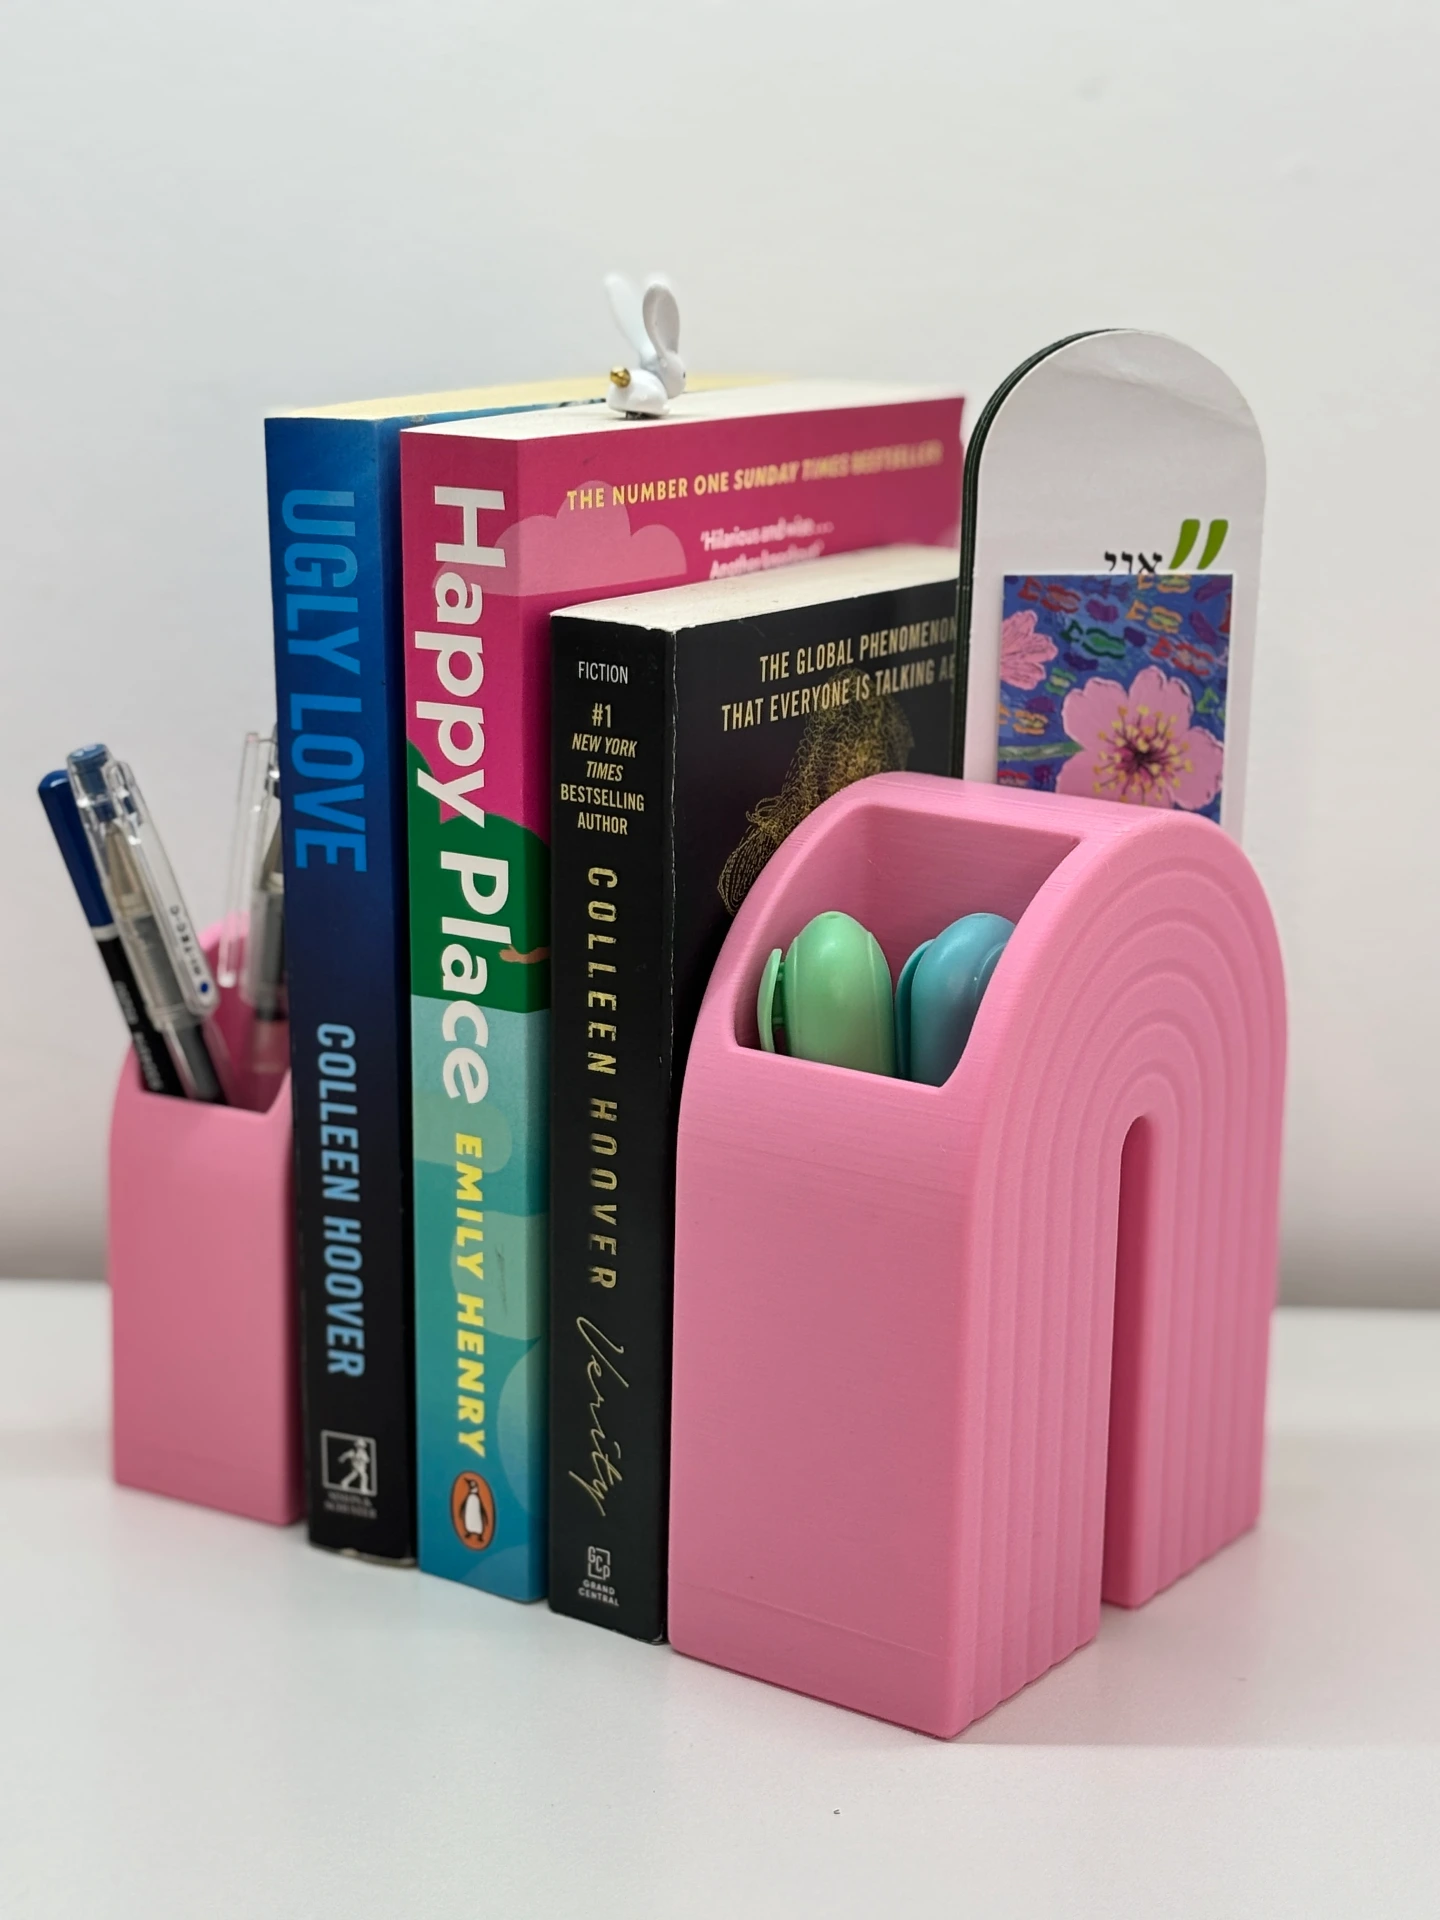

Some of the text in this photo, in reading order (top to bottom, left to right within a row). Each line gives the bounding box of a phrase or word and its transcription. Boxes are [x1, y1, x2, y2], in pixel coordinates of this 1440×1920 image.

[567, 488, 605, 511] THE
[612, 475, 688, 506] NUMBER
[693, 469, 730, 496] ONE
[733, 461, 799, 491] SUNDAY
[801, 452, 849, 481] TIMES
[281, 488, 368, 872] UGLY LOVE
[578, 660, 629, 685] FICTION
[759, 651, 790, 683] THE
[796, 638, 854, 675] GLOBAL
[591, 702, 612, 729] #1
[721, 697, 764, 732] THAT
[769, 678, 850, 722] EVERYONE
[855, 674, 870, 700] IS
[875, 658, 935, 696] TALKING
[571, 732, 638, 758] NEW YORK
[586, 760, 624, 782] TIMES
[414, 485, 512, 1104] Happy Place
[560, 783, 645, 813] BESTSELLING
[577, 811, 628, 836] AUTHOR
[587, 865, 618, 1290] COLLEEN HOOVER
[317, 1023, 365, 1377] COLLEEN HOOVER
[455, 1132, 486, 1459] EMILY HENRY
[568, 1316, 629, 1518] Verity
[578, 1587, 620, 1607] CENTRAL
[583, 1579, 616, 1596] GRAND
